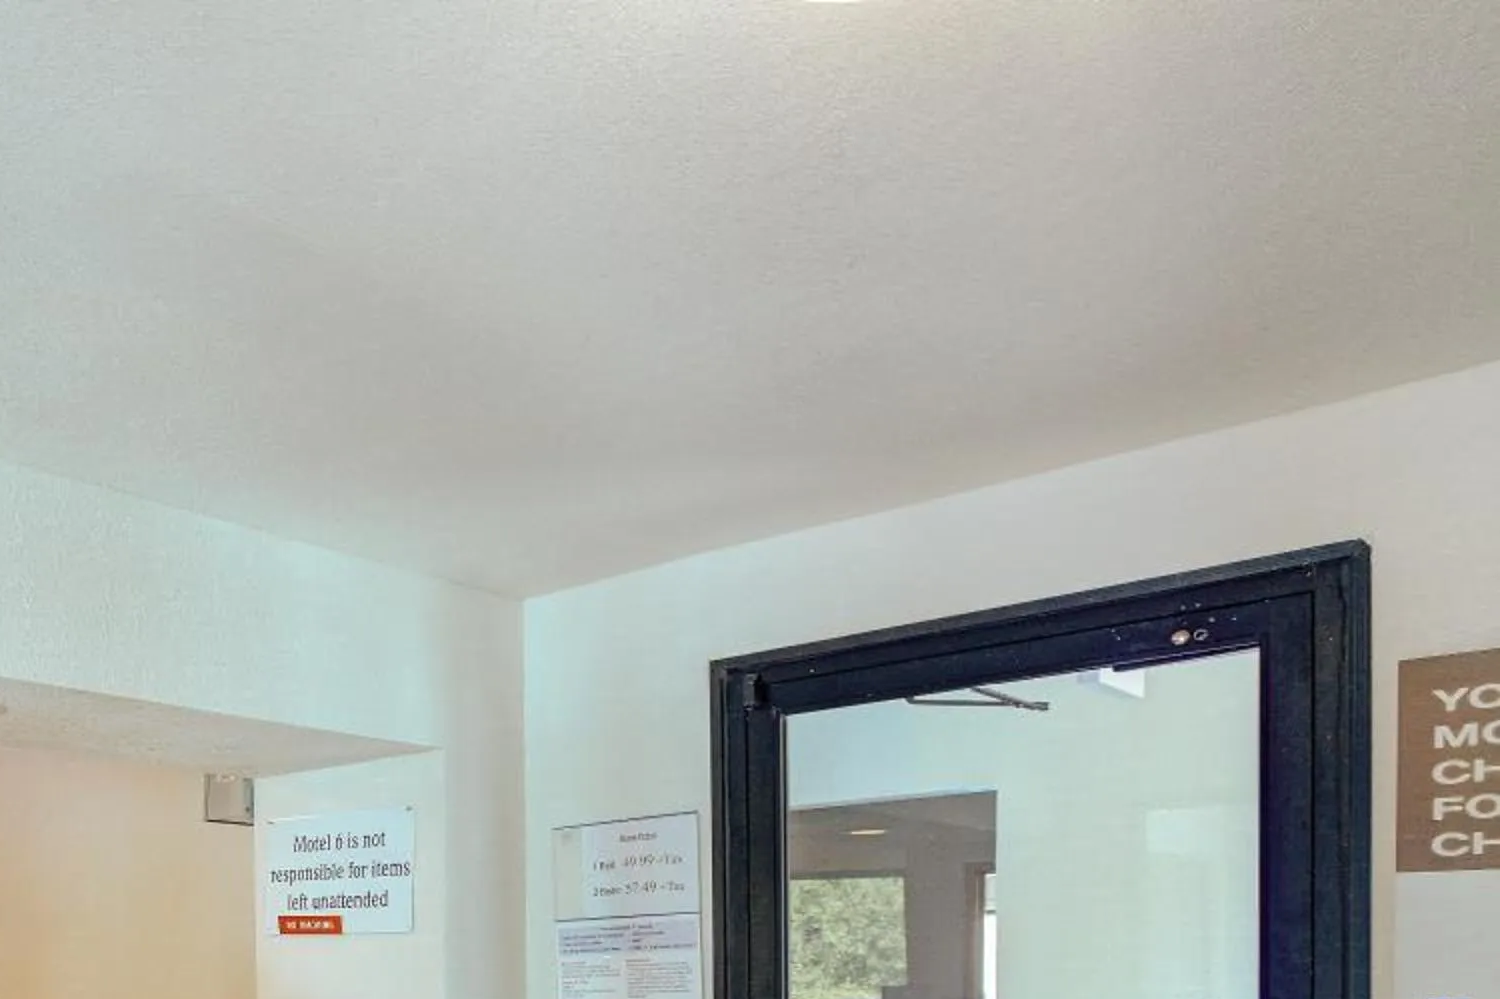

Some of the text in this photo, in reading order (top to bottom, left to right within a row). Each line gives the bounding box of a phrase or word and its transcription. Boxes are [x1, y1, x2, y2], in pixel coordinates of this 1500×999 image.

[293, 831, 386, 852] Motel 6 is not
[270, 860, 411, 886] responsible for items
[287, 889, 389, 911] left unattended
